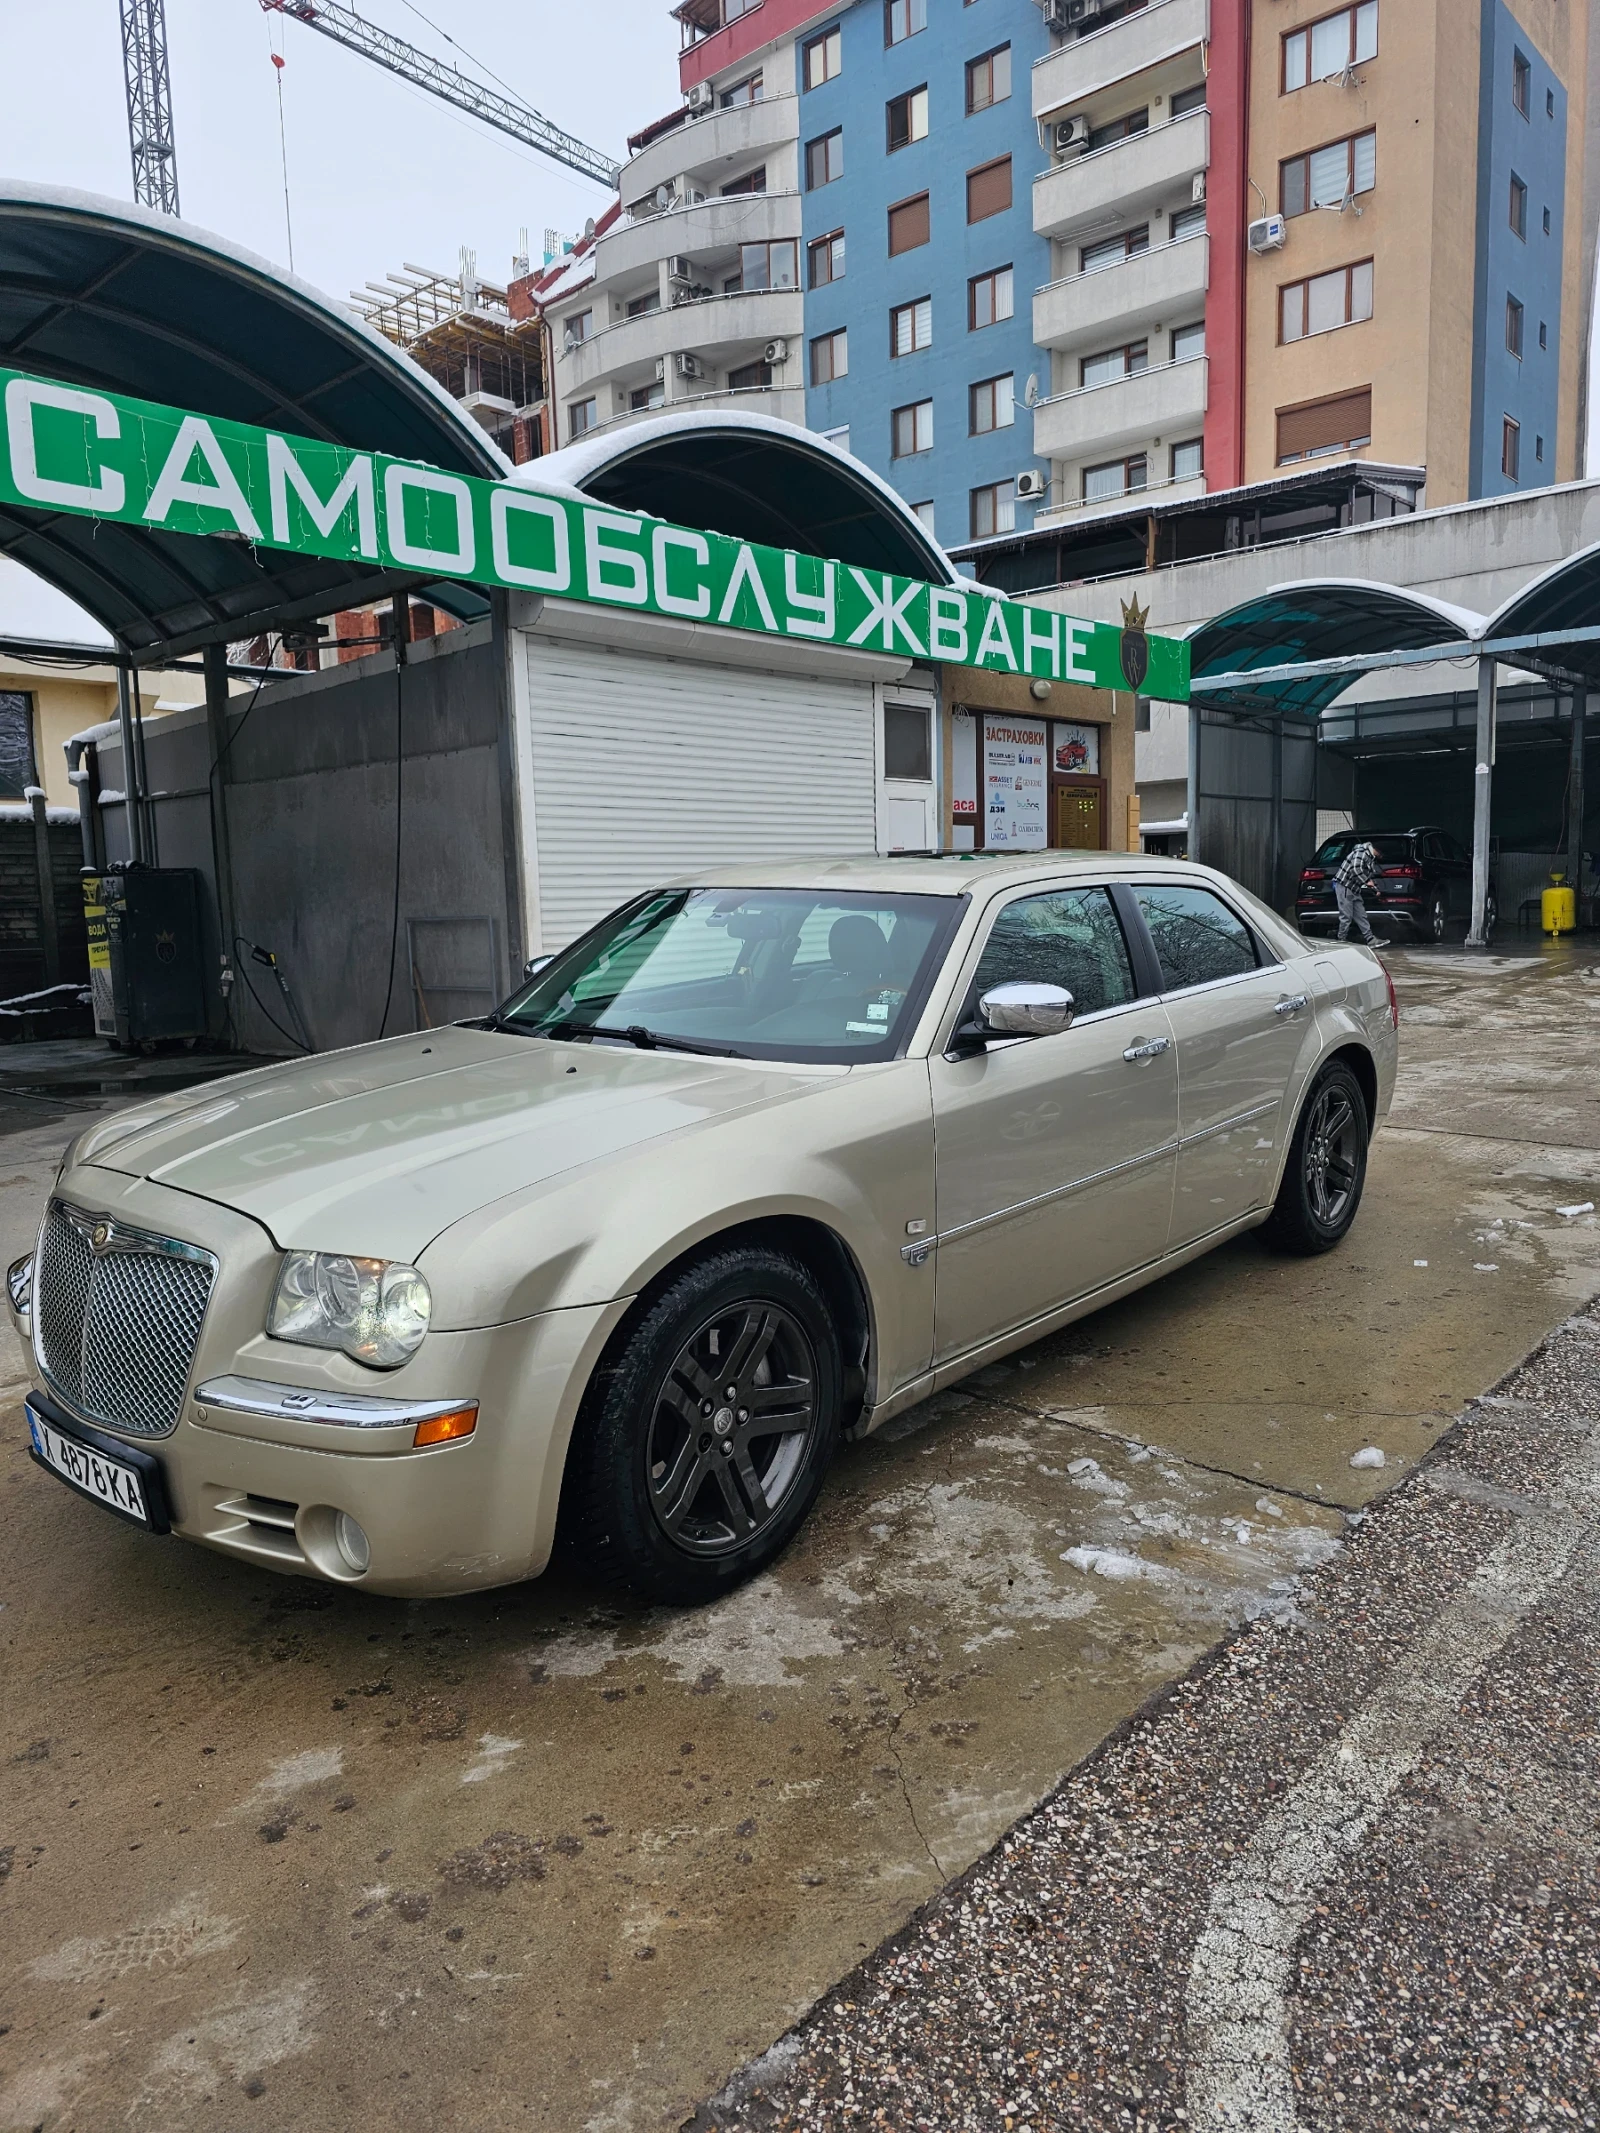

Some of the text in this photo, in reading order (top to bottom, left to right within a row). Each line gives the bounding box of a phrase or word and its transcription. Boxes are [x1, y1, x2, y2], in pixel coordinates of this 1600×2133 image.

[5, 378, 1096, 683] САМООБСЛУЖВАНЕ
[986, 727, 1045, 746] ЗАСТРАХОВКИ
[88, 923, 107, 937] ВОДА
